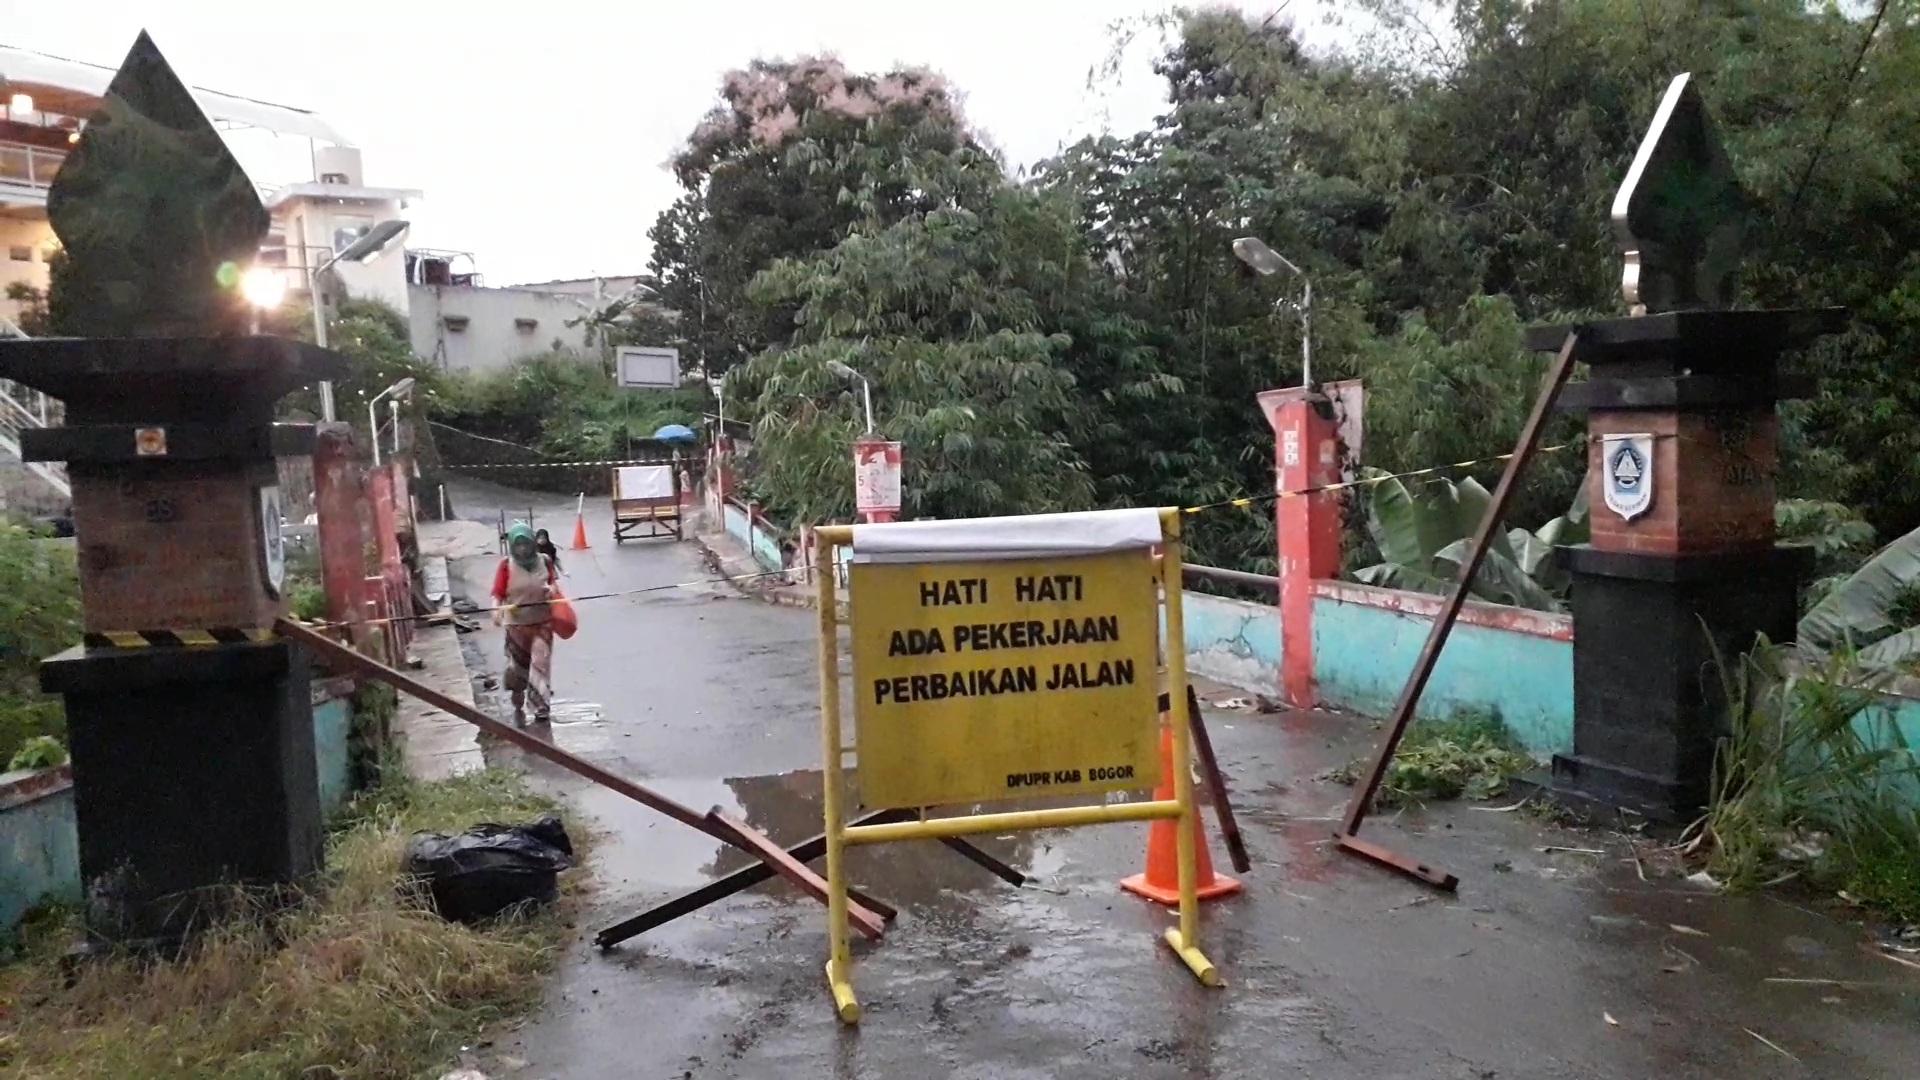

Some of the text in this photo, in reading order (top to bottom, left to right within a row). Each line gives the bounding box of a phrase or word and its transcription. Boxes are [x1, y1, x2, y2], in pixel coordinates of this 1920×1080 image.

[921, 575, 1083, 606] HATI HATI
[888, 615, 1119, 657] ADA PEKERJAAN
[874, 659, 1134, 705] PERBAIKAN JALAN
[1007, 765, 1134, 788] DPUPR KAB BOGOR
